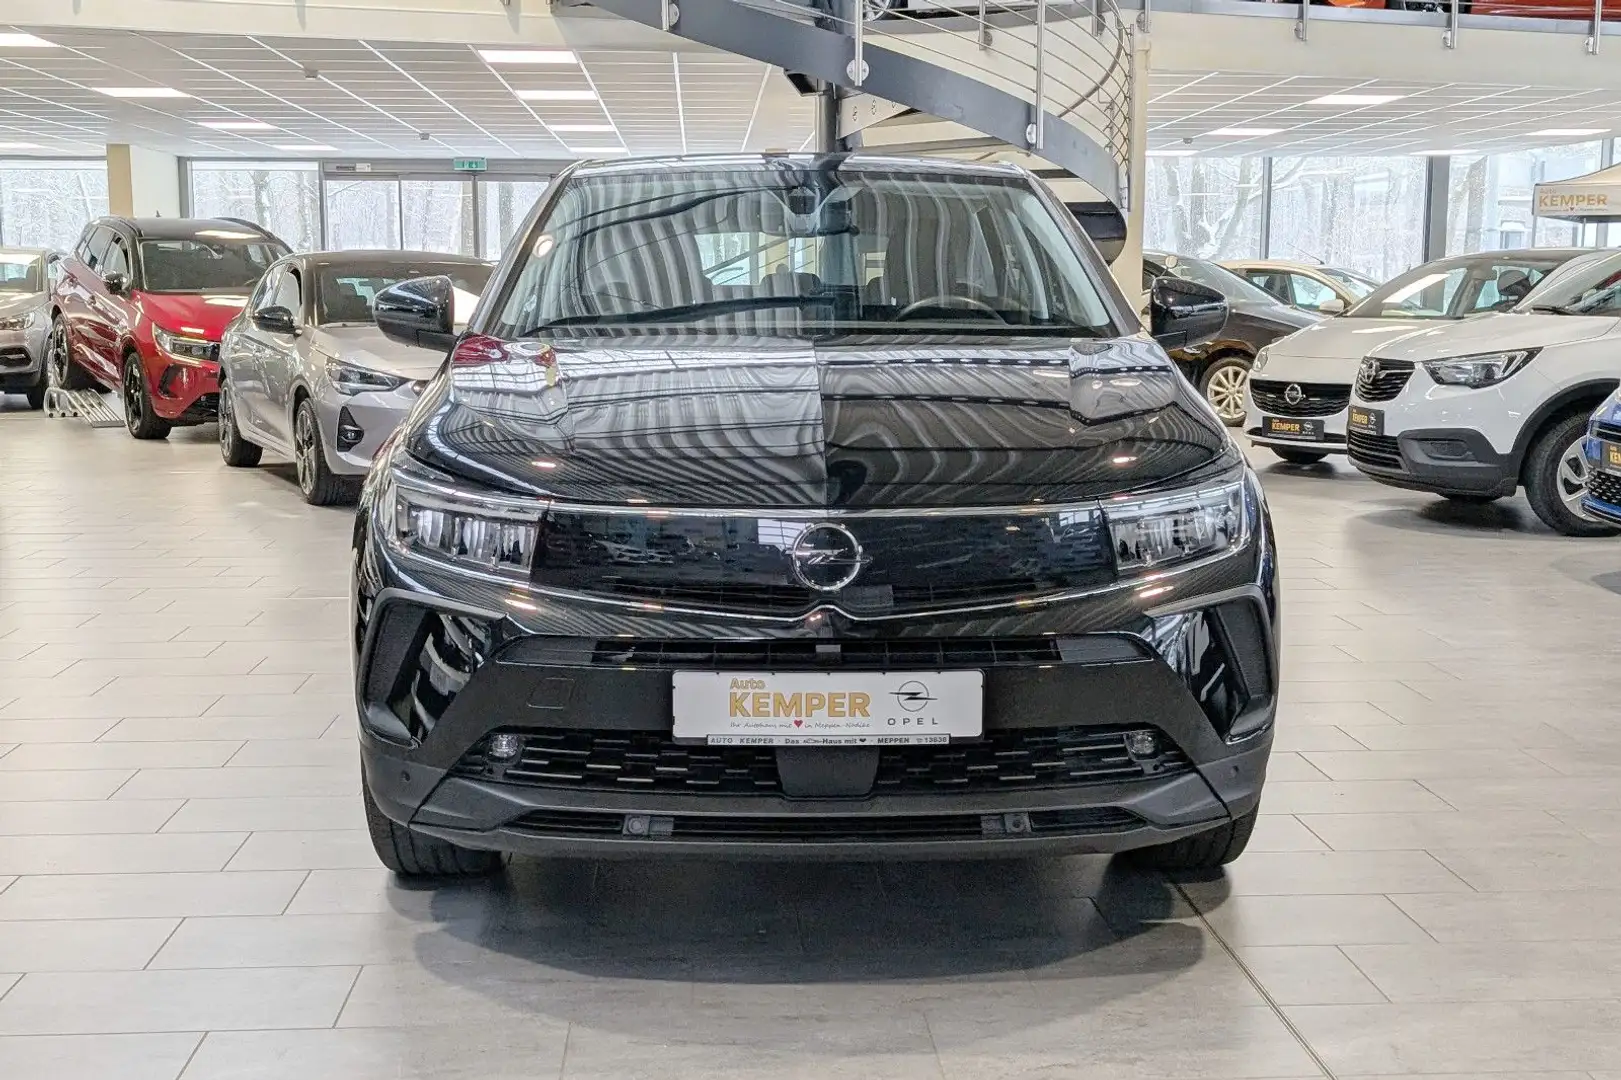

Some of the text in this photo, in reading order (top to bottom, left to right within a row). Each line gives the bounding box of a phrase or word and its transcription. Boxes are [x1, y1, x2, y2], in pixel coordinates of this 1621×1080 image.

[1538, 194, 1608, 207] KEMPER
[1271, 422, 1300, 432] KEMPER
[729, 677, 766, 690] Auto
[729, 691, 871, 717] KEMPER
[887, 717, 939, 726] OPEL
[785, 737, 800, 745] Das
